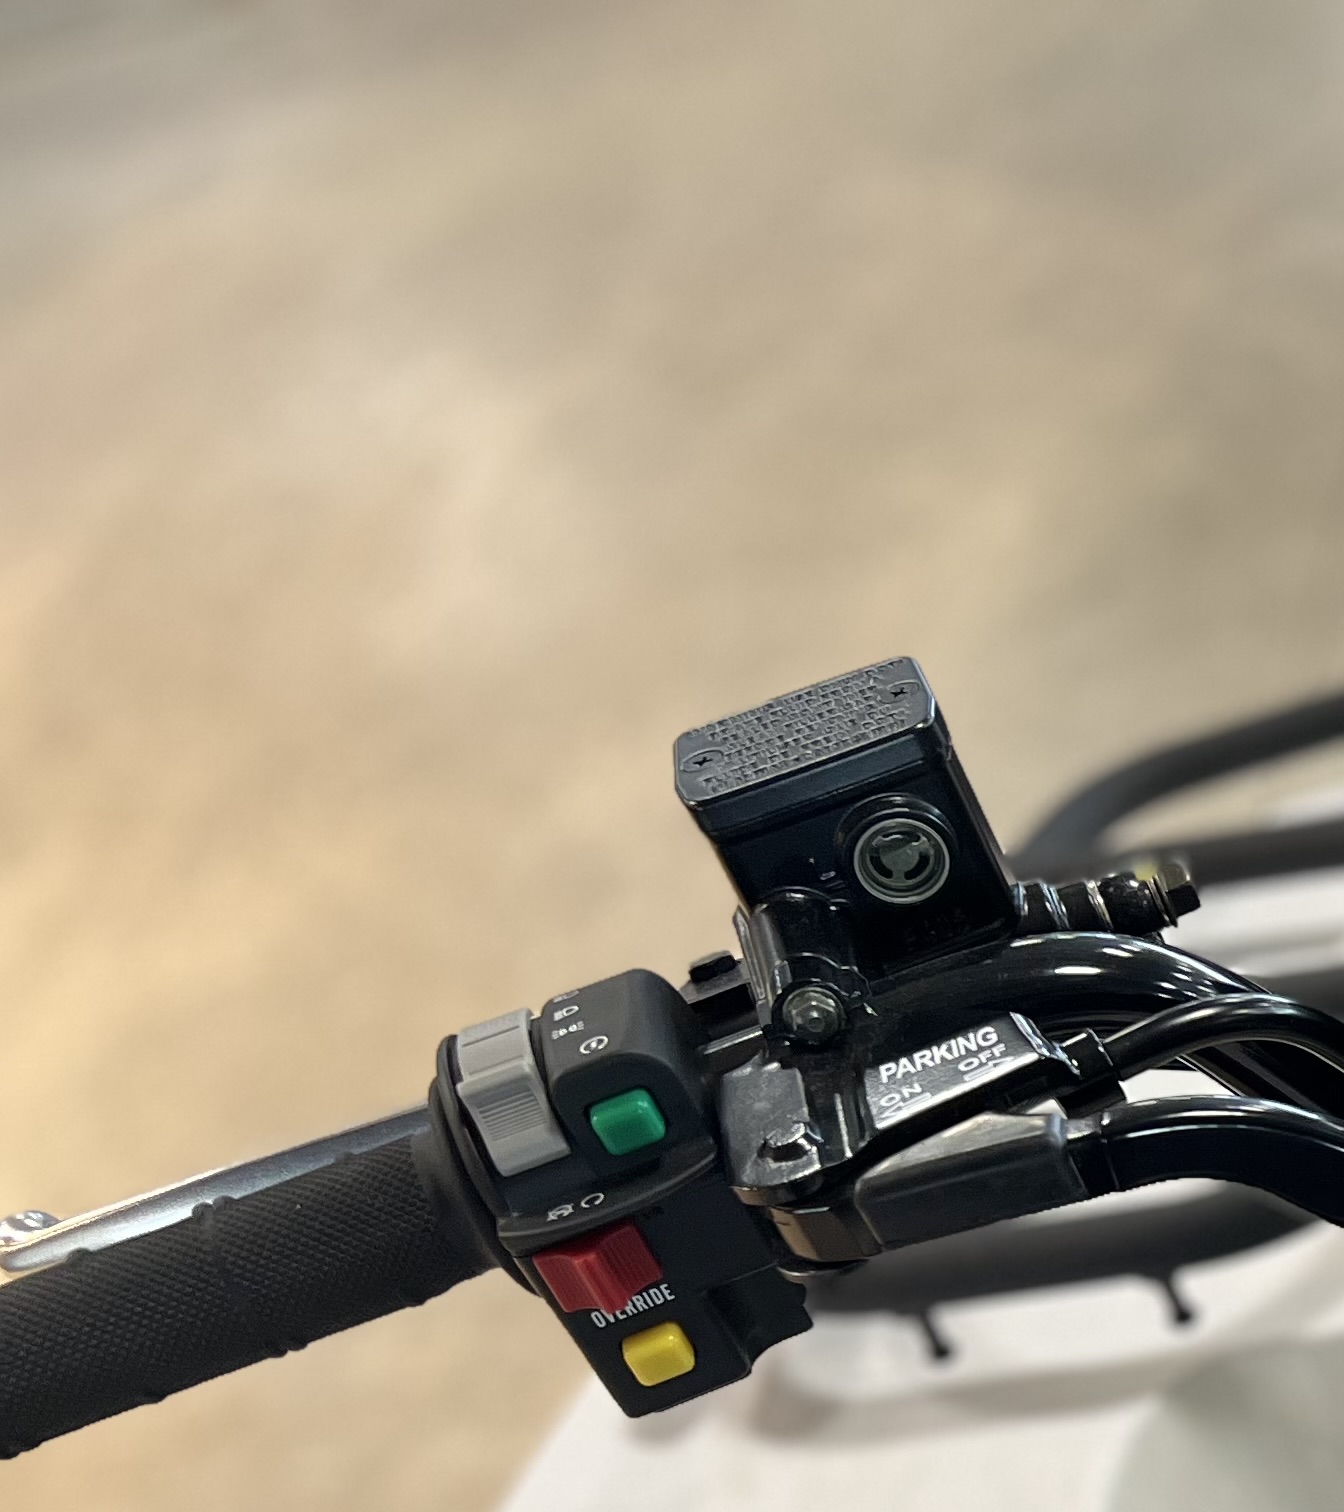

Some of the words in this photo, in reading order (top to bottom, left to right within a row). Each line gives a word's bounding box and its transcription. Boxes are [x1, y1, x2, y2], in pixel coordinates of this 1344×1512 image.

[879, 1026, 998, 1083] PARKING
[958, 1043, 1006, 1071] OFF
[880, 1083, 922, 1106] ON
